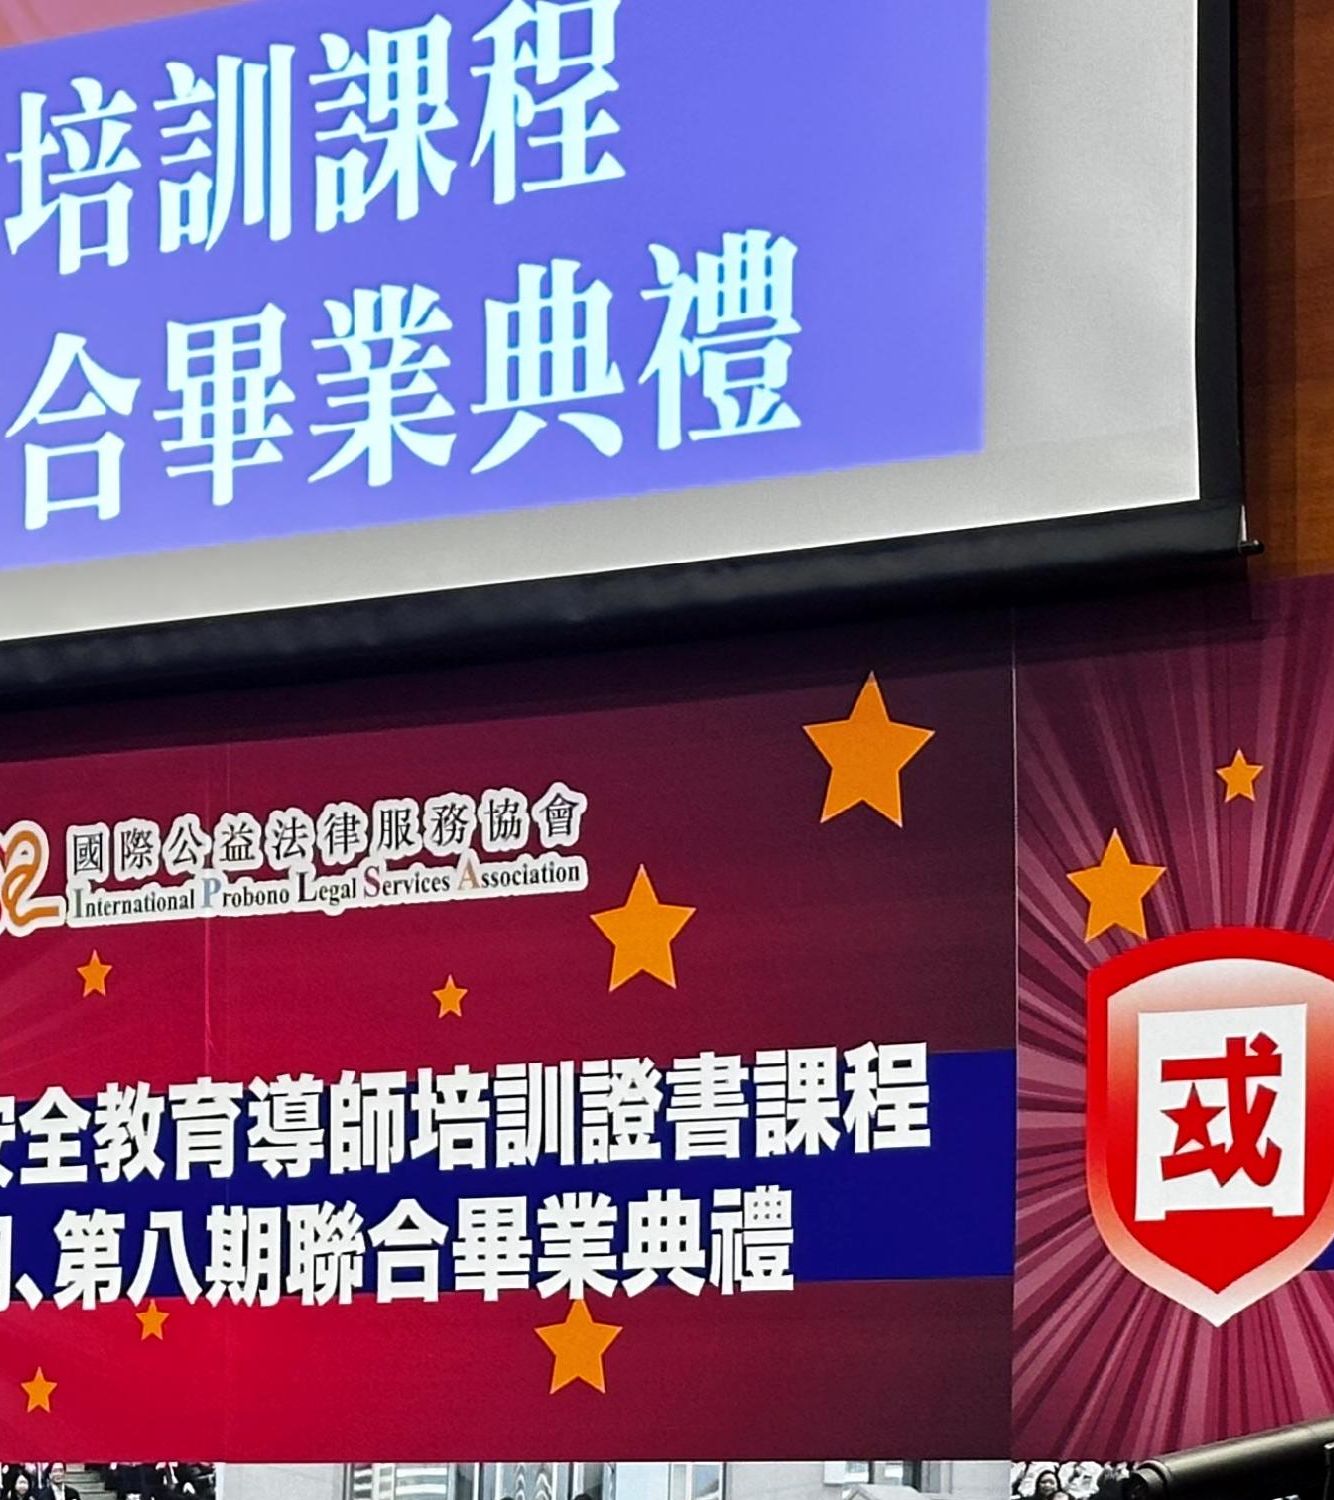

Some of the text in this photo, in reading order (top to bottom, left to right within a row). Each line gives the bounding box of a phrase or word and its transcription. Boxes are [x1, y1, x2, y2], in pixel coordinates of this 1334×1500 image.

[71, 791, 580, 876] 國際公益法律服務協會
[72, 861, 581, 919] International Probono Legal Services Association
